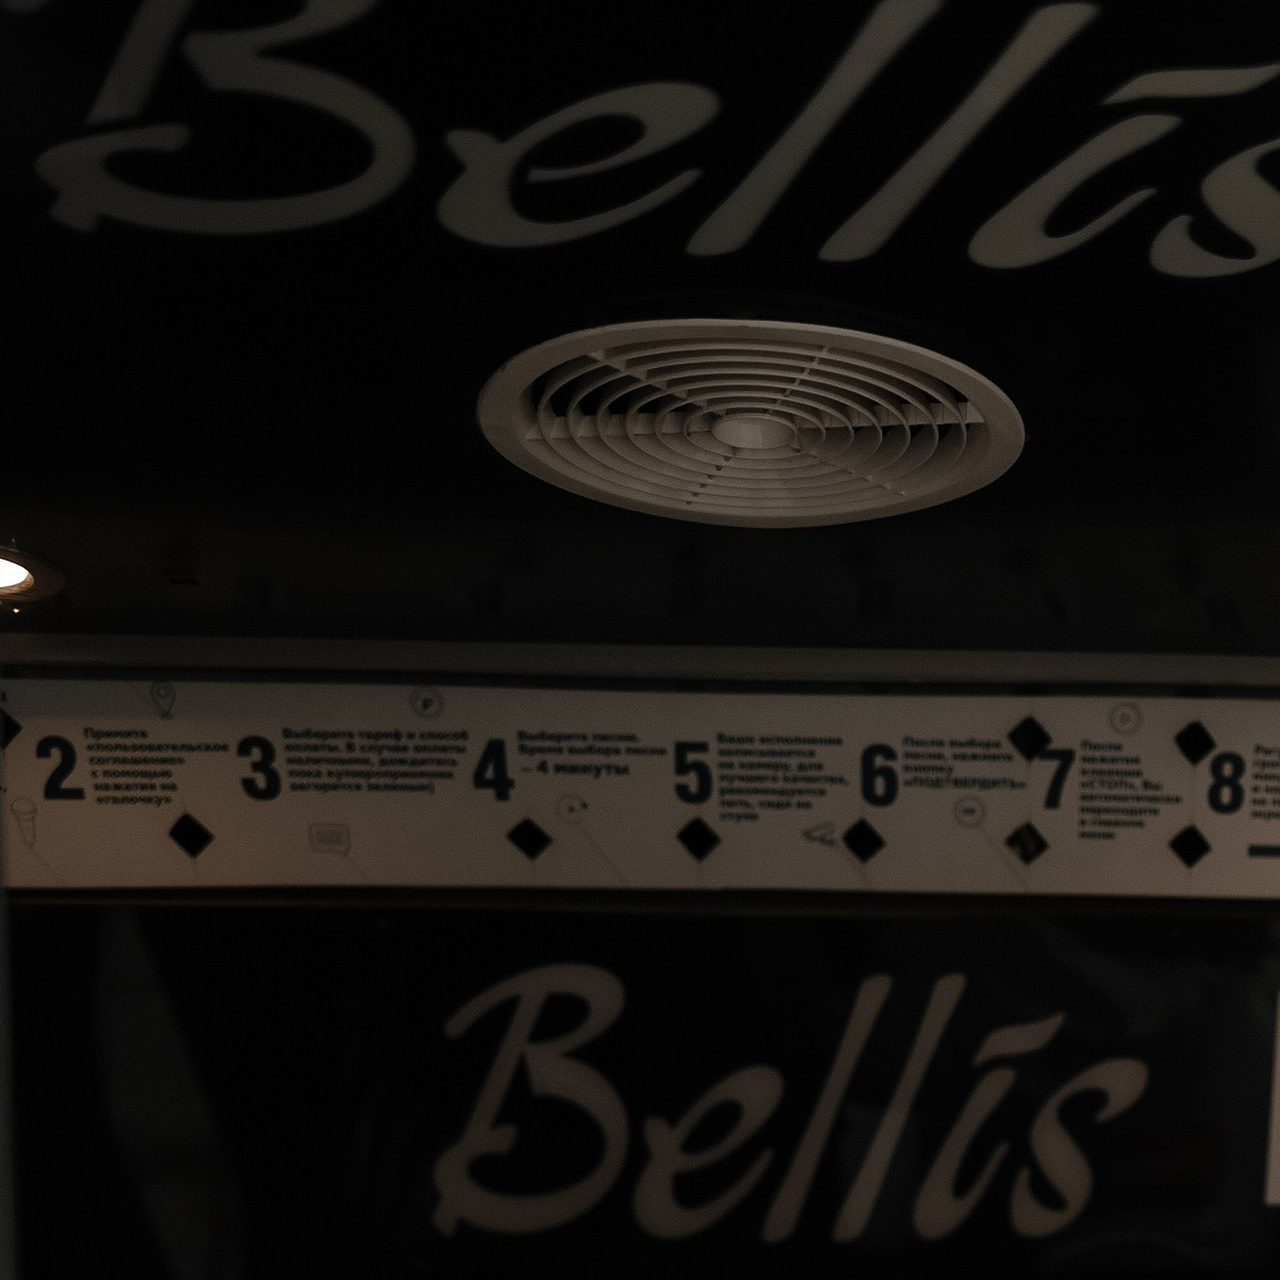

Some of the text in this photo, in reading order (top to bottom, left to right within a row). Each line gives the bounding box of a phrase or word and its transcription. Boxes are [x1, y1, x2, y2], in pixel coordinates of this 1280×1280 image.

[84, 727, 148, 740] Примите
[36, 735, 85, 800] 2
[237, 735, 281, 800] 3
[472, 738, 515, 801] 4
[537, 760, 549, 774] 4
[554, 763, 630, 779] минуты
[674, 741, 712, 803] 5
[860, 743, 898, 807] 6
[1037, 748, 1076, 809] 7
[1208, 752, 1246, 814] 8
[433, 962, 1150, 1244] Bellis
